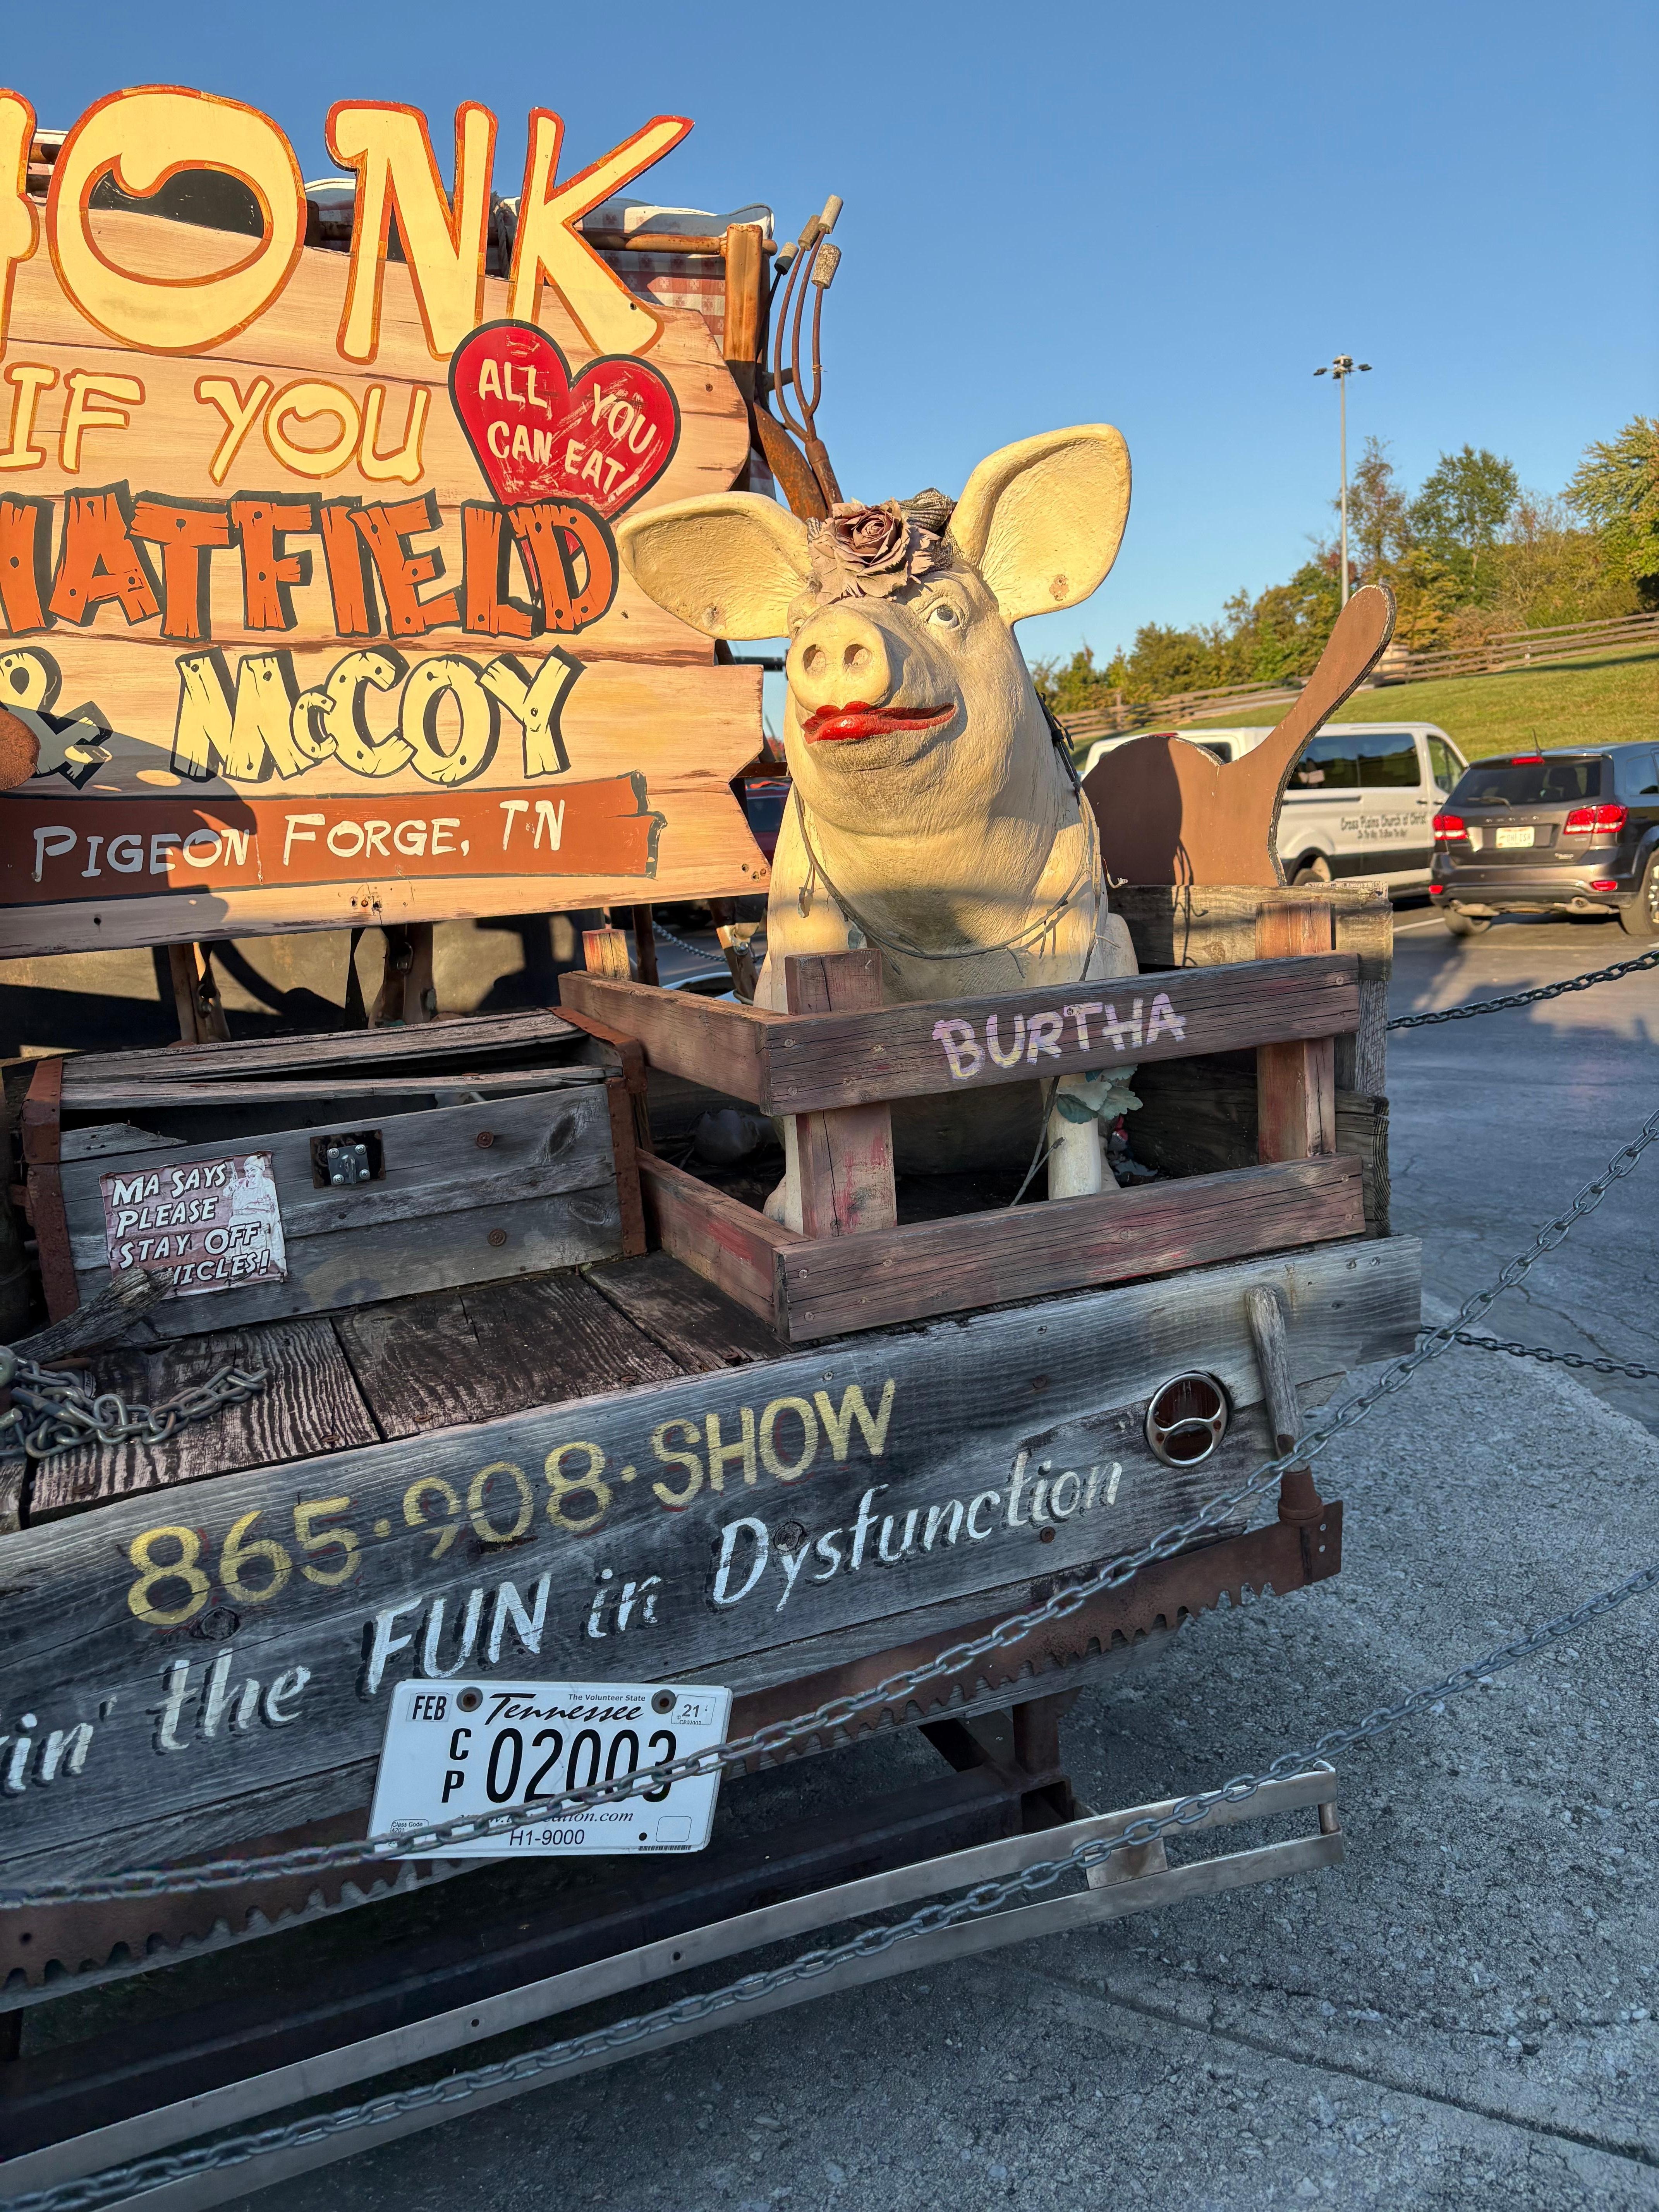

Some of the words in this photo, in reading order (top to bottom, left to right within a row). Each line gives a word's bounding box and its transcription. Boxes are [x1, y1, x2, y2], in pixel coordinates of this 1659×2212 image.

[0, 361, 146, 475] IF
[195, 375, 432, 486] YOU
[479, 359, 547, 409] ALL
[591, 383, 657, 454] YOU
[487, 421, 553, 466] CAN
[565, 439, 639, 503] EAT!
[33, 826, 249, 883] PIGEON
[284, 813, 470, 866] FORGE,
[499, 799, 565, 851] TN
[1381, 814, 1401, 827] Church
[1403, 813, 1410, 826] of
[933, 993, 1186, 1080] BURTHA
[112, 1174, 159, 1207] MA
[171, 1163, 226, 1199] SAYS
[116, 1196, 219, 1239] PLEASE
[118, 1233, 191, 1270] STAY
[204, 1221, 261, 1255] OFF
[0, 1695, 117, 1791] in'
[158, 1648, 310, 1750] the
[366, 1571, 551, 1695] FUN
[587, 1568, 661, 1639] in
[713, 1450, 1123, 1613] Dysfunction
[412, 1695, 447, 1720] FEB
[484, 1693, 644, 1725] Tennessee
[682, 1704, 700, 1717] 21
[485, 1728, 677, 1804] 02003
[509, 1829, 585, 1846] H1-9000
